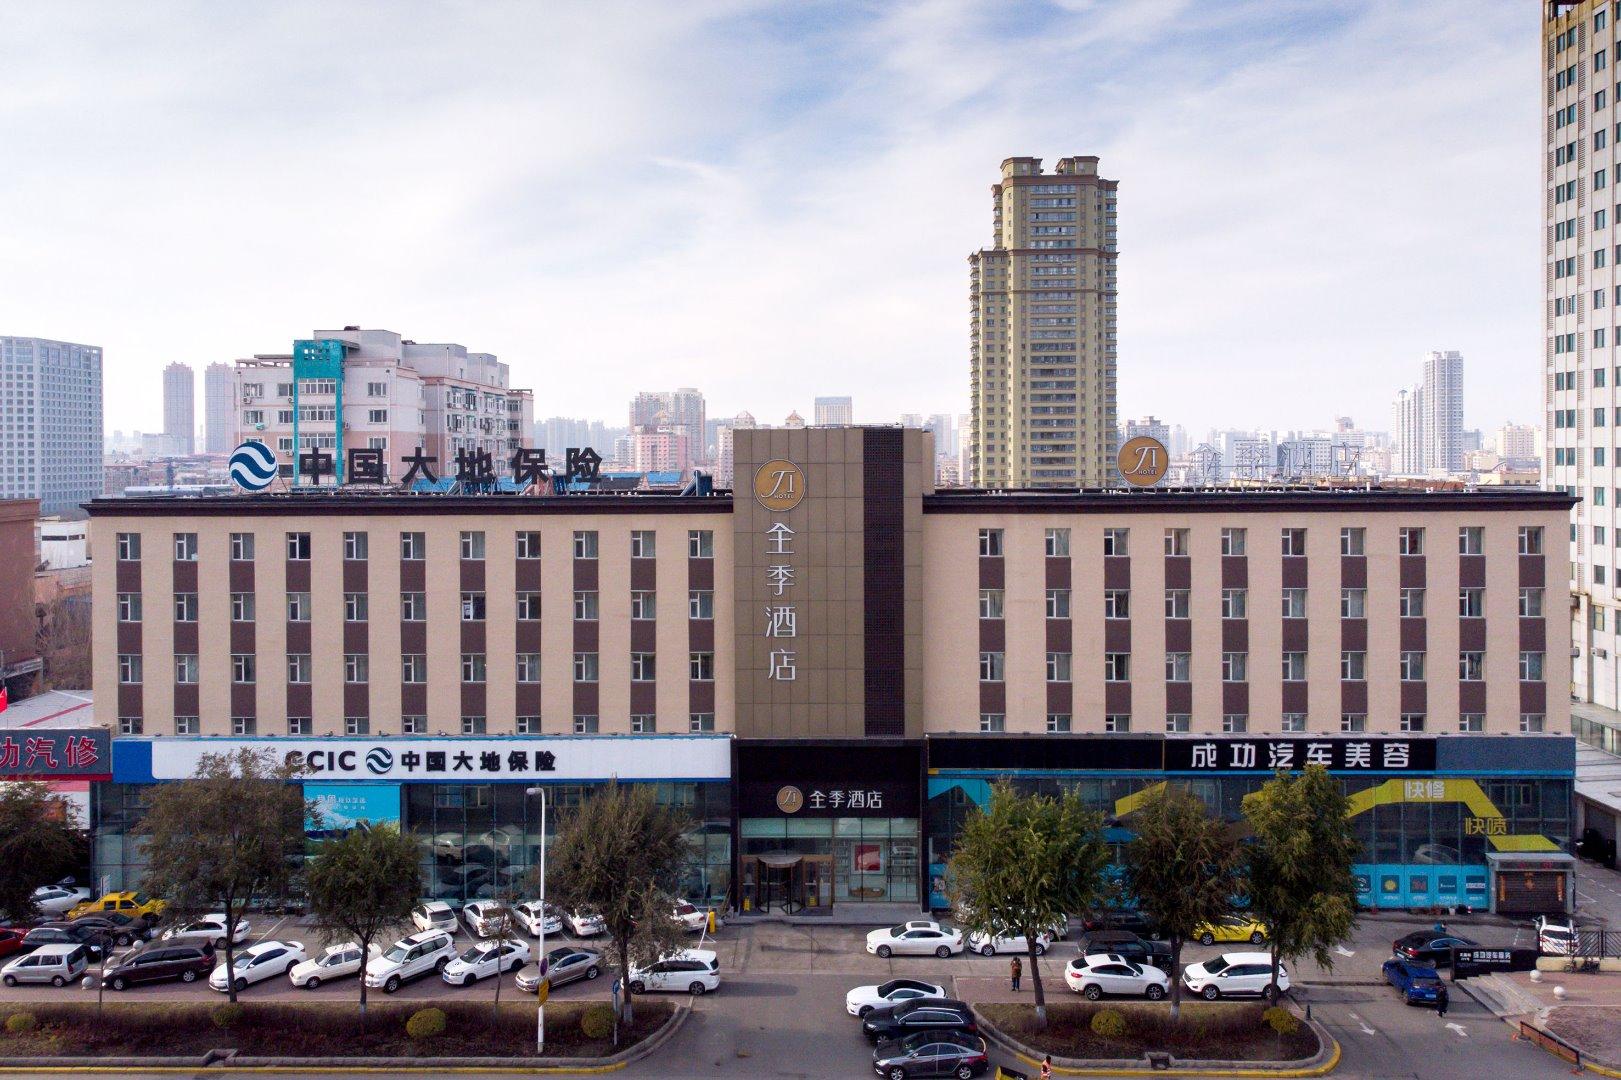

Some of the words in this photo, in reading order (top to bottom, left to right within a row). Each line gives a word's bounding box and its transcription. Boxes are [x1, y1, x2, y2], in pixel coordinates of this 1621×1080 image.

[299, 446, 603, 485] 中国大地保险
[765, 522, 796, 681] 全季酒店
[401, 750, 556, 772] 中国大地保险
[1191, 742, 1410, 768] 成功汽车美容
[809, 790, 883, 809] 全季酒店
[1404, 780, 1445, 800] 快修
